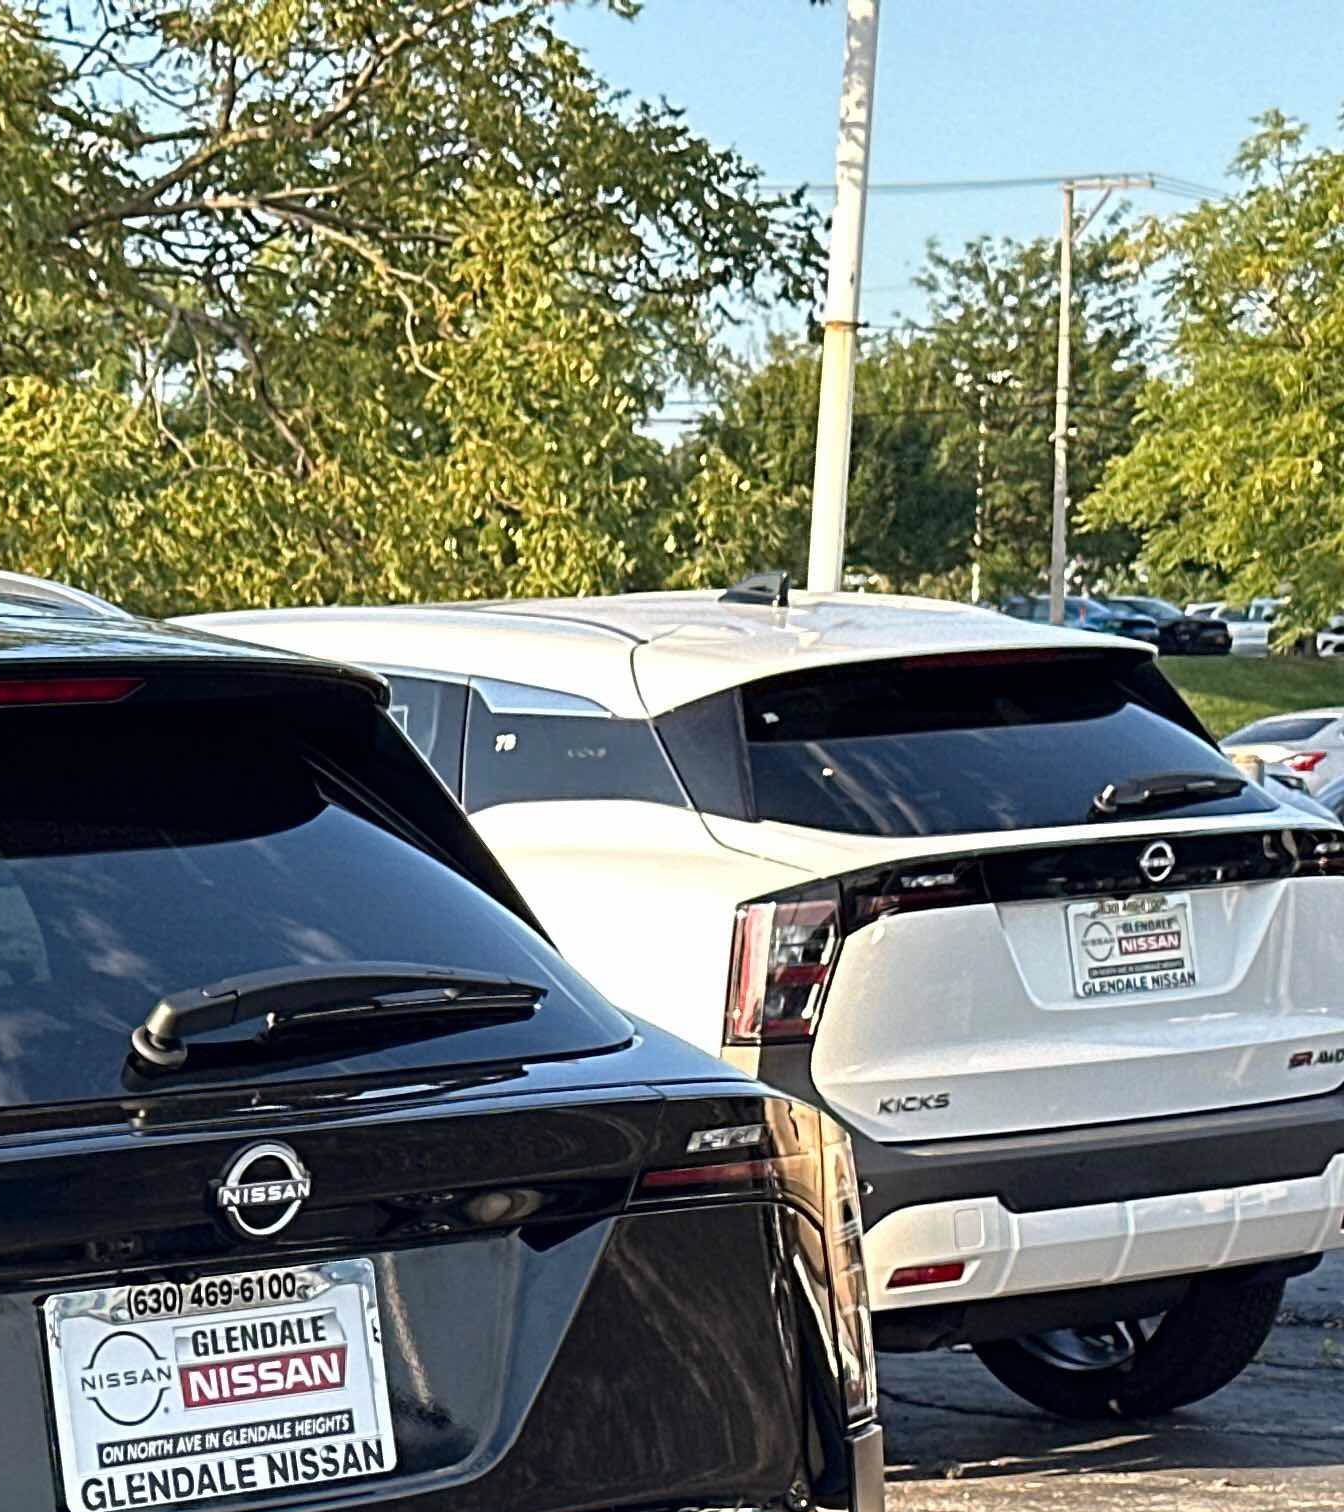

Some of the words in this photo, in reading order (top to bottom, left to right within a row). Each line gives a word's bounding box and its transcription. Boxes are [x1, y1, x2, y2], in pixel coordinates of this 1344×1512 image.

[1120, 933, 1179, 954] NISSAN
[1082, 975, 1149, 996] GLENDALE
[1150, 971, 1196, 989] NISSAN
[878, 1092, 950, 1114] KICKS
[222, 1182, 310, 1205] NISSAN
[127, 1283, 183, 1320] (630)
[190, 1272, 296, 1307] 469-6100
[192, 1315, 327, 1357] GLENDALE
[80, 1365, 172, 1392] NISSAN
[188, 1352, 341, 1402] NISSAN
[102, 1445, 124, 1464] ON
[127, 1438, 173, 1460] NORTH
[176, 1433, 202, 1454] AVE
[205, 1432, 219, 1449] IN
[222, 1421, 292, 1447] GLENDALE
[295, 1413, 350, 1438] HEIGHTS
[81, 1456, 257, 1511] GLENDALE
[267, 1438, 385, 1485] NISSAN
